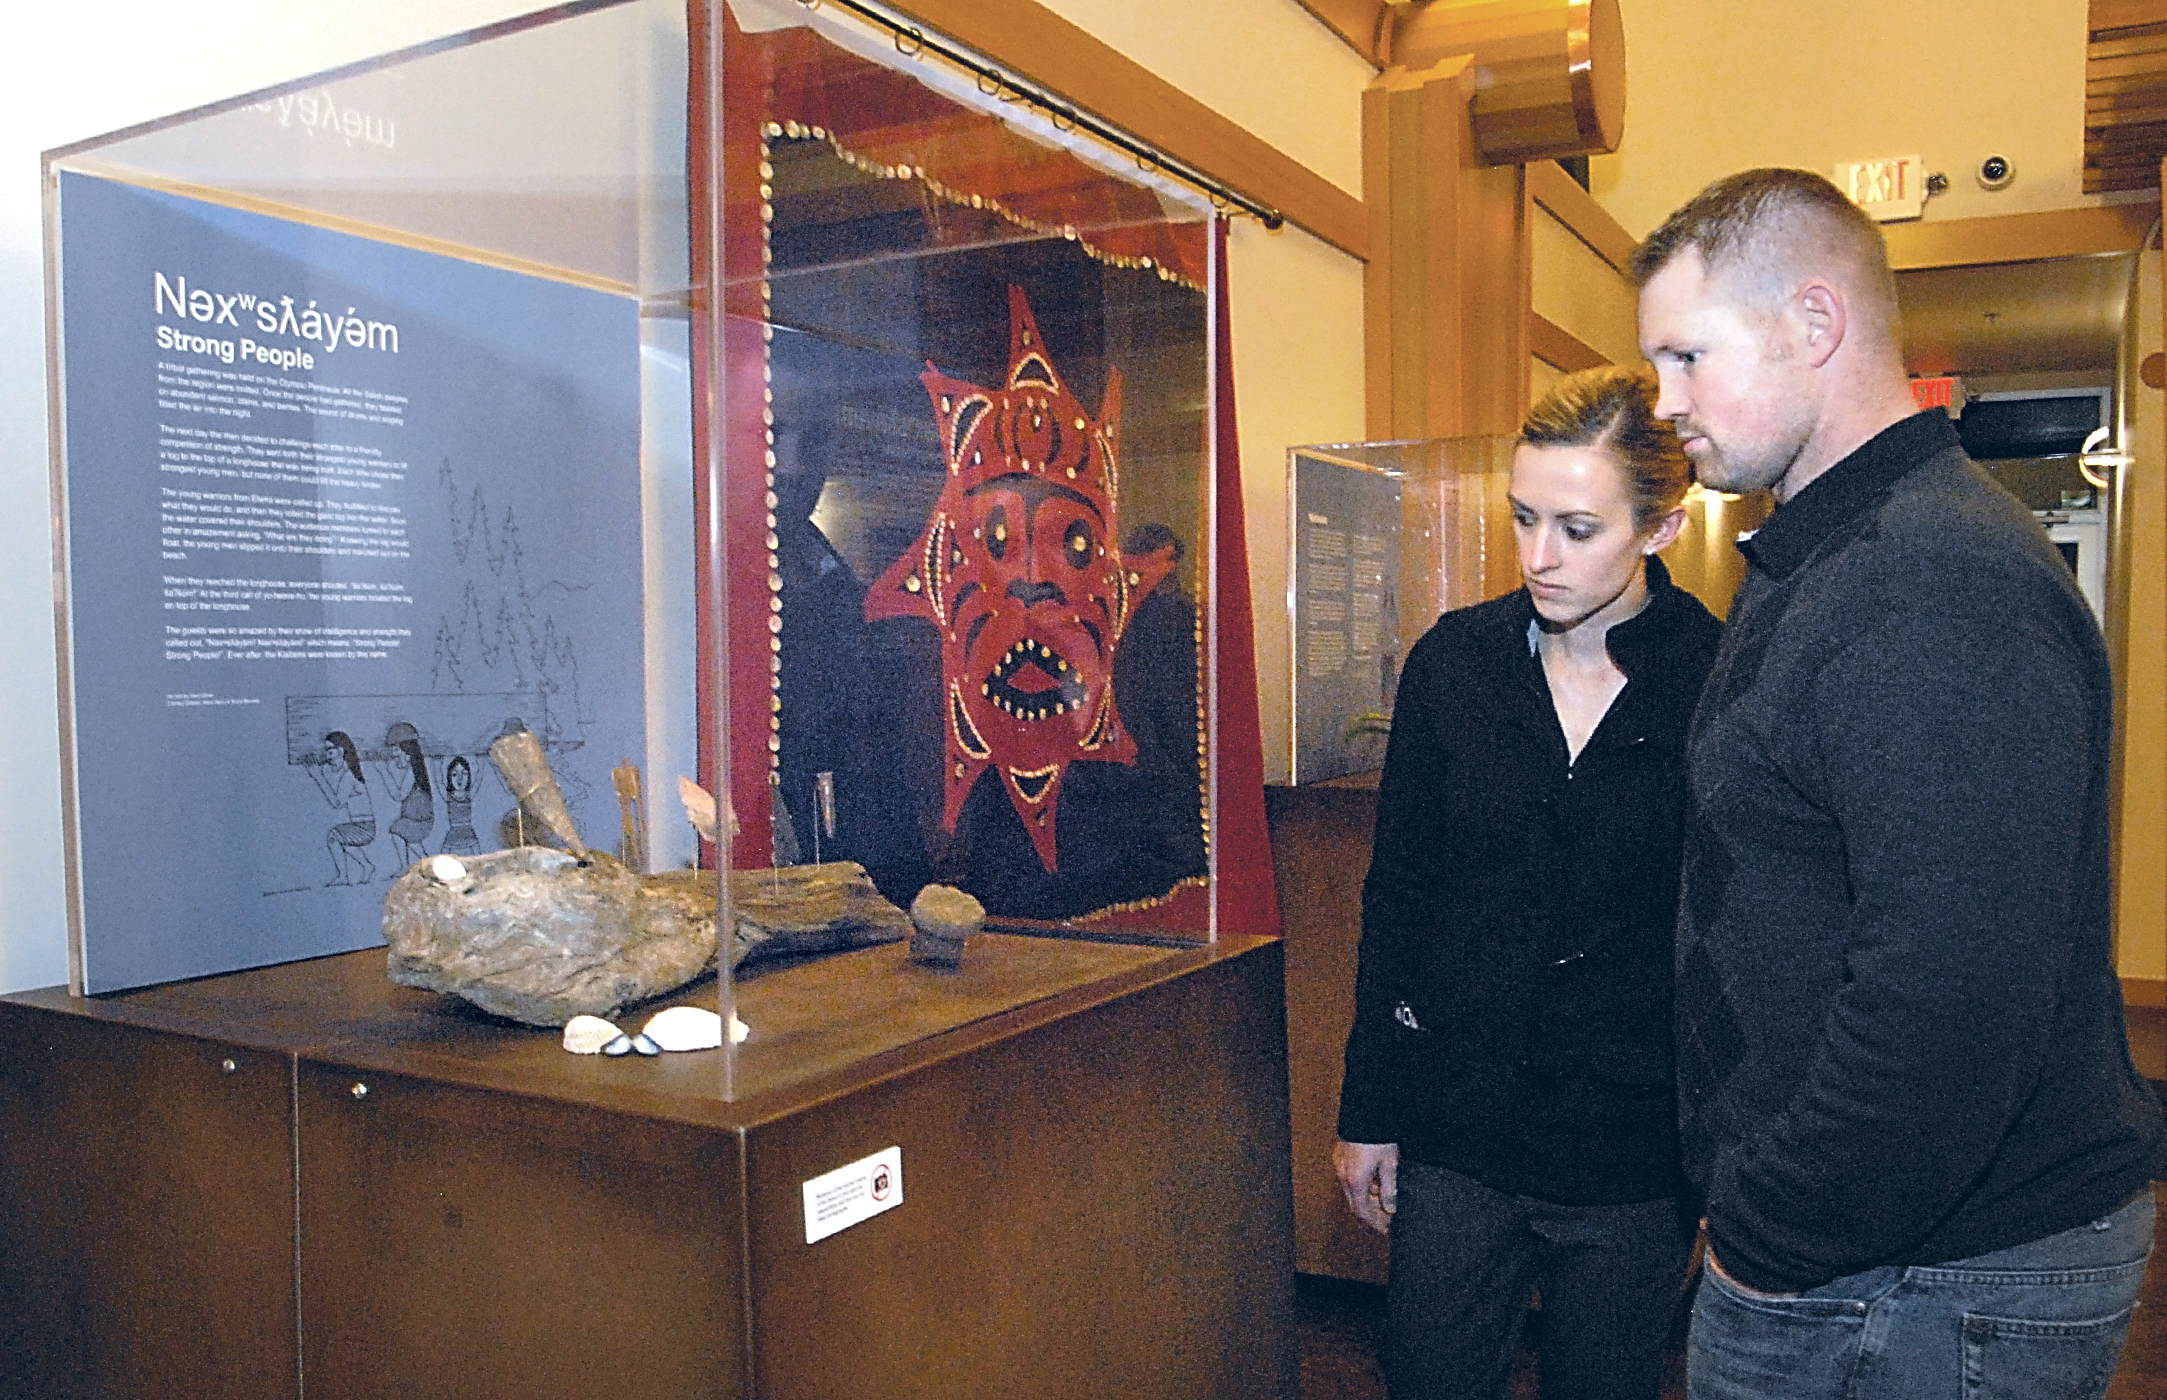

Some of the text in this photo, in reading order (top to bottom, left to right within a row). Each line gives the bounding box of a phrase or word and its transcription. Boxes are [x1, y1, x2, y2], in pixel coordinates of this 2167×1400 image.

[1848, 159, 1909, 204] EXIT
[156, 326, 314, 370] Strong People
[1911, 377, 1955, 408] EXIT
